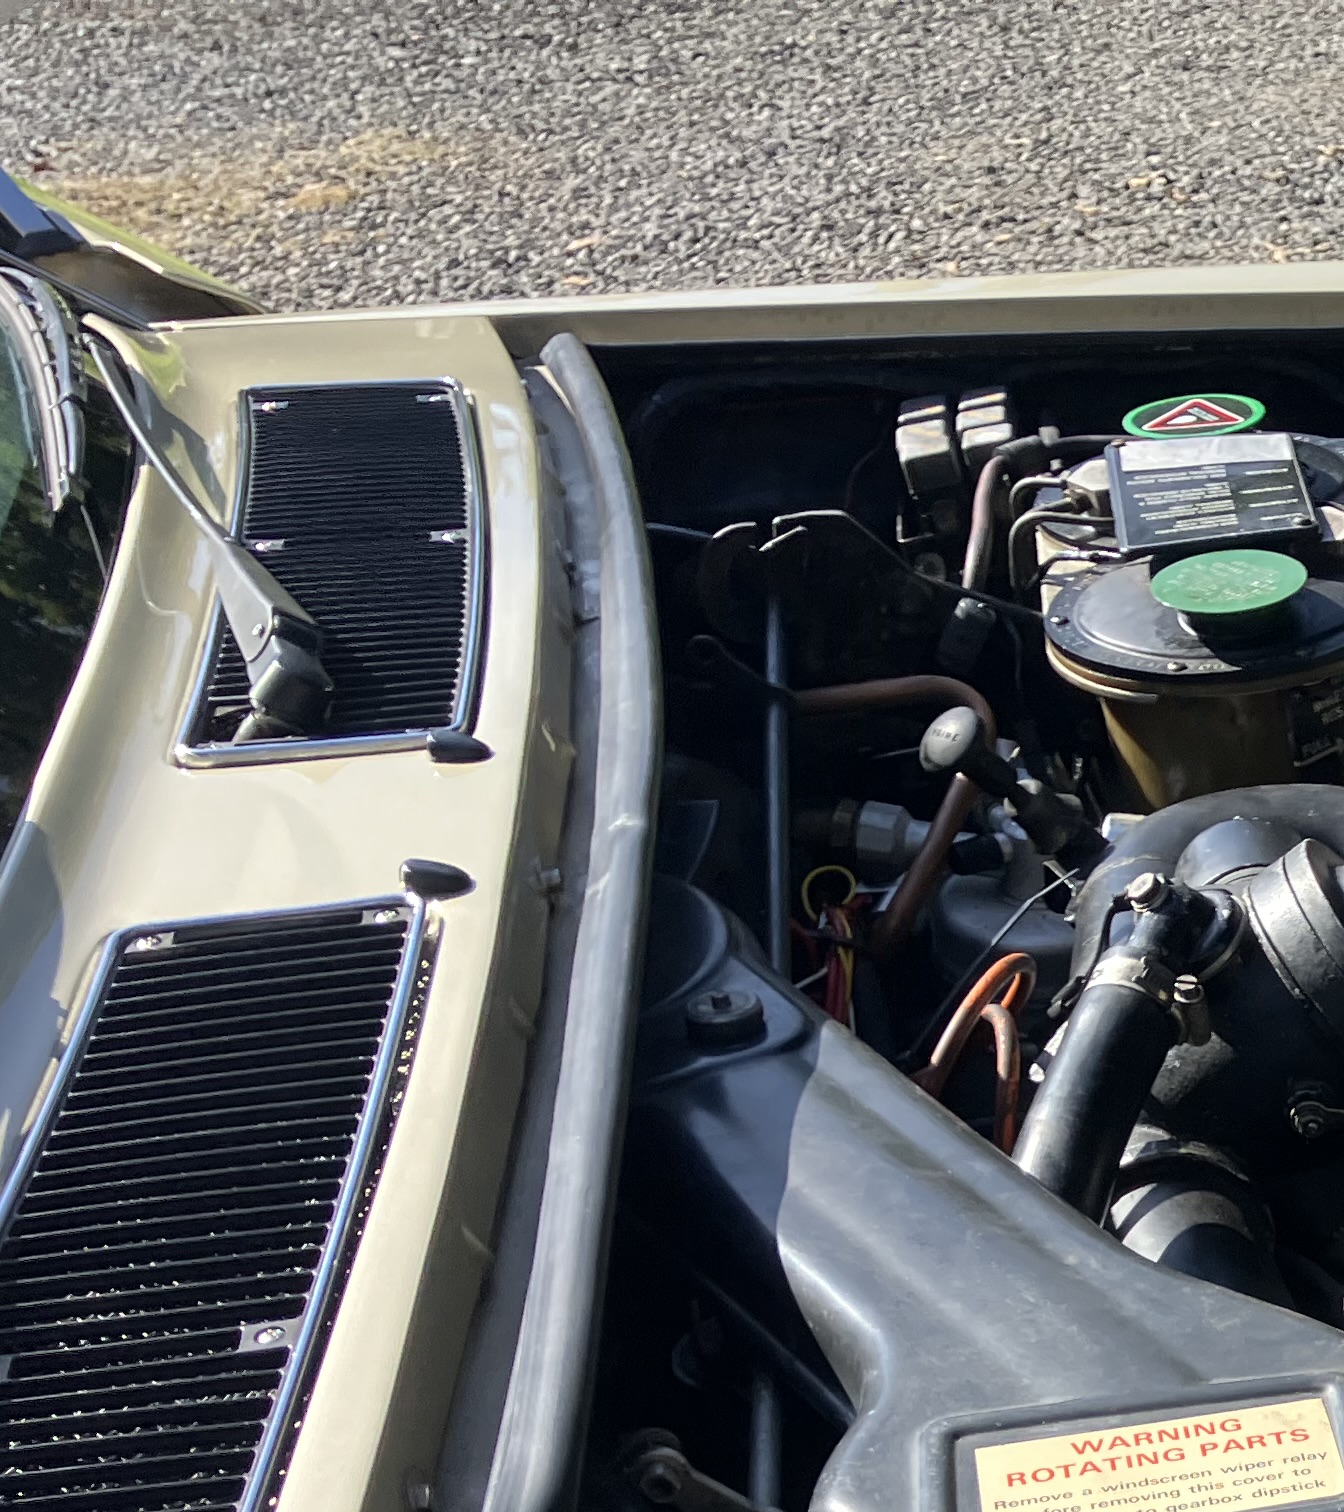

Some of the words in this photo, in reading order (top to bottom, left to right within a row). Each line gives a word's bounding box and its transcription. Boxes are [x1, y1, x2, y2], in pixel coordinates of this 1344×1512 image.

[1006, 1447, 1186, 1487] ROTATING
[1201, 1428, 1310, 1457] PARTS
[1070, 1418, 1242, 1454] WARNING
[994, 1490, 1073, 1511] Remove
[1082, 1487, 1093, 1497] a
[1101, 1468, 1212, 1493] windscreen
[1220, 1457, 1274, 1476] wiper
[1282, 1449, 1328, 1465] relay
[1090, 1487, 1181, 1512] removing
[1188, 1478, 1225, 1495] this
[1232, 1470, 1285, 1487] cover
[1292, 1466, 1312, 1478] to
[1251, 1479, 1327, 1500] dipstick
